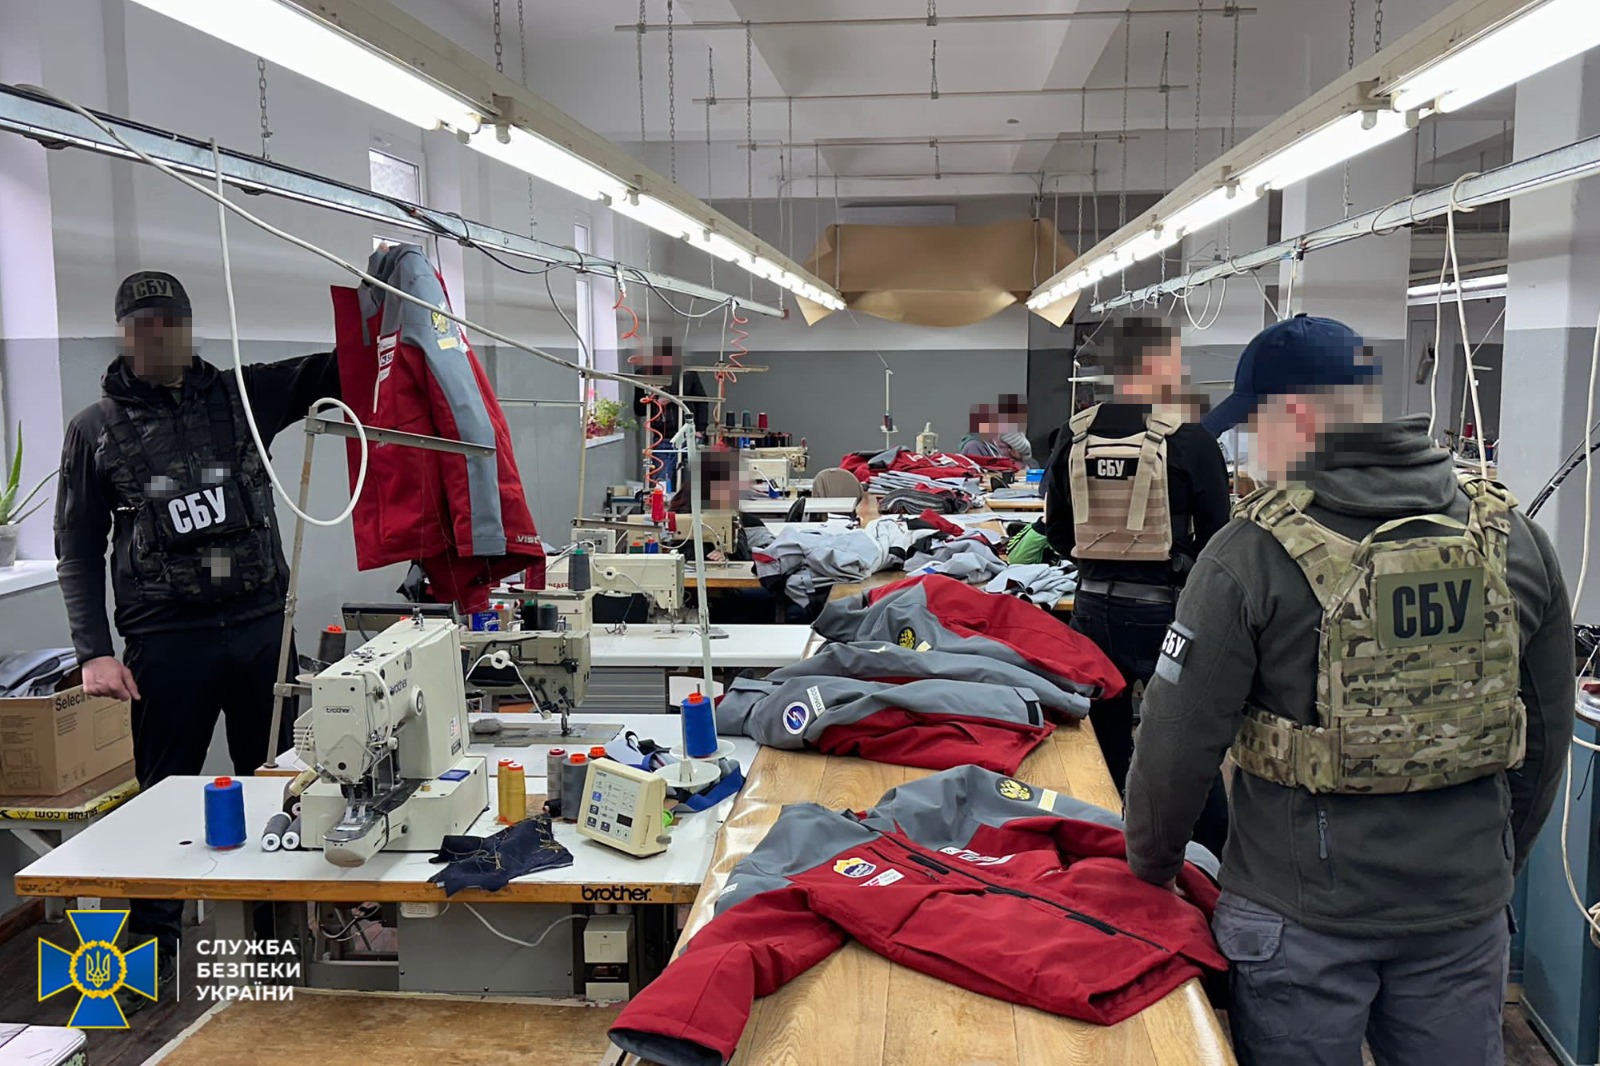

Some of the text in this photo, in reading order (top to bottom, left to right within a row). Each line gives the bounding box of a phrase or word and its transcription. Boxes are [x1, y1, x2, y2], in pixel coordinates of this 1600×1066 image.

[136, 280, 168, 297] СБУ
[1097, 459, 1125, 477] СБУ
[168, 486, 226, 534] СБУ
[1392, 579, 1472, 639] СБУ
